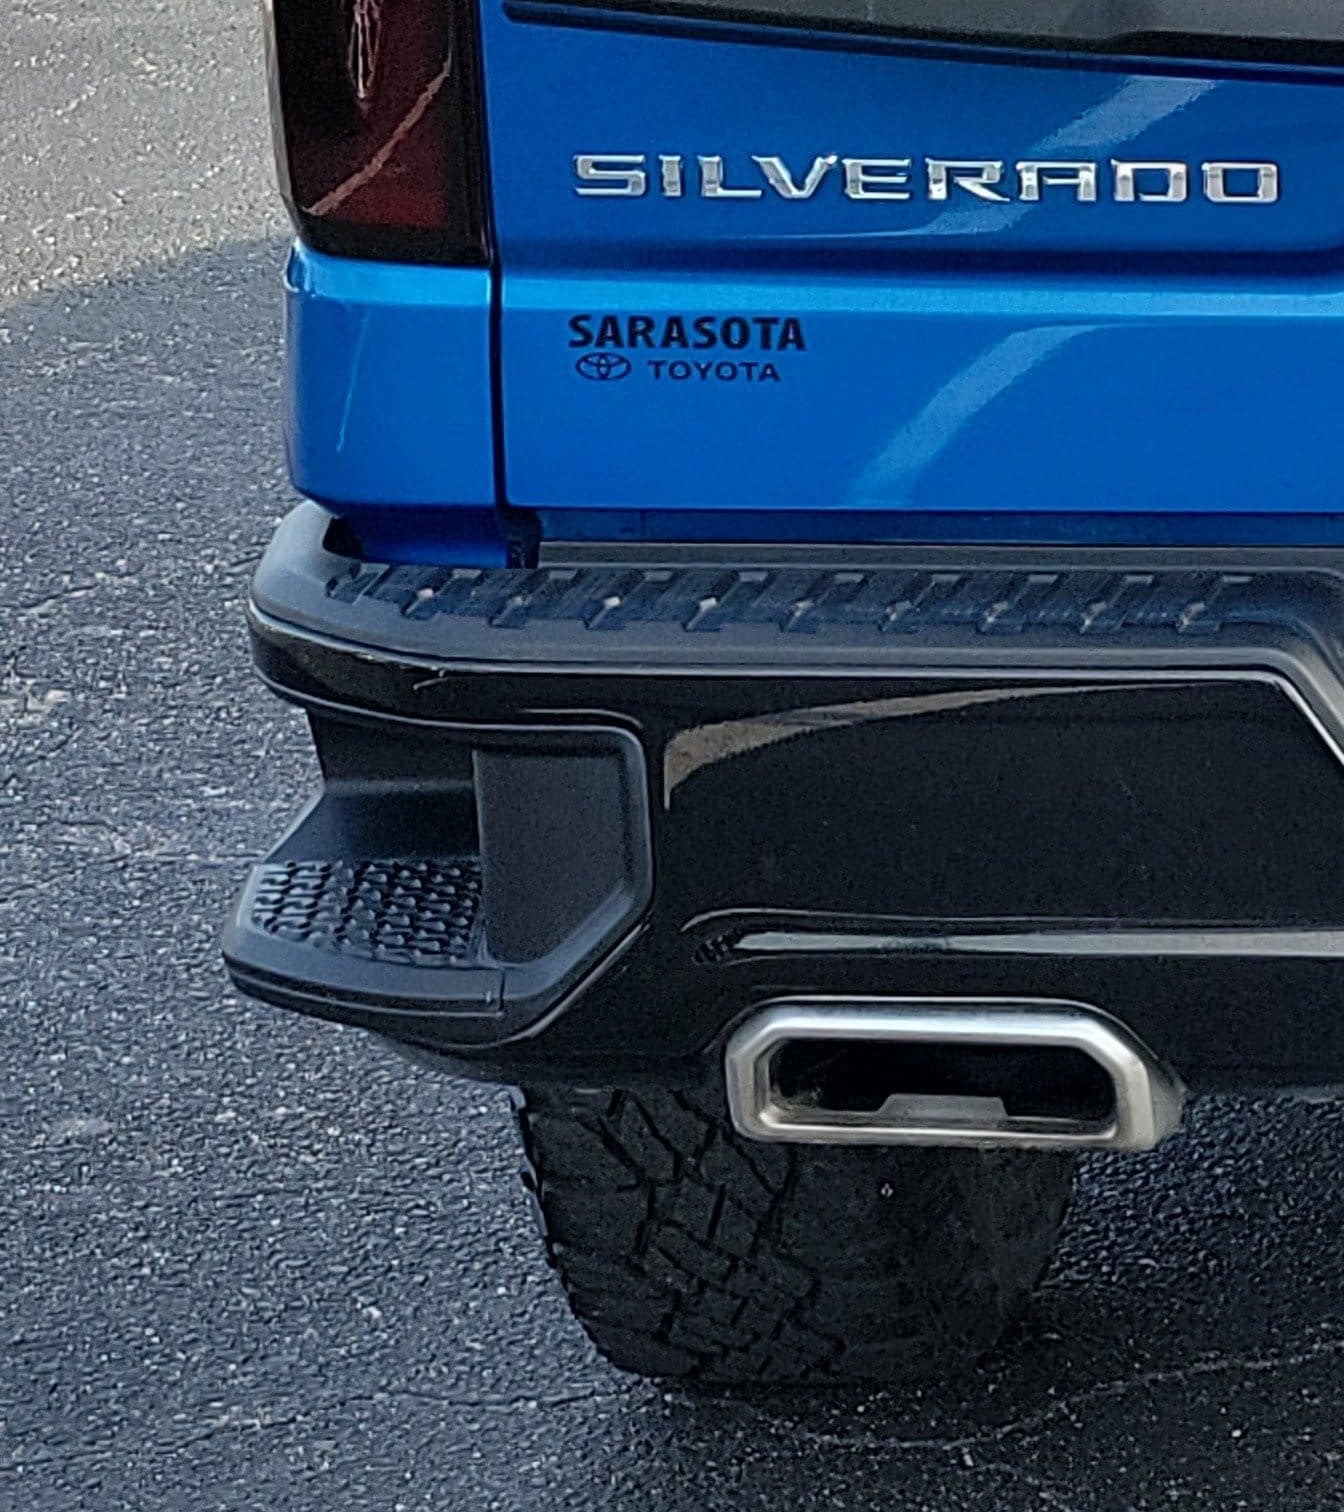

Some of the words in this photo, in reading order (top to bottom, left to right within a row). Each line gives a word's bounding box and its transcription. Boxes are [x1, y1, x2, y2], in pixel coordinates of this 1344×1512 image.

[573, 153, 1279, 204] SILVERADO
[568, 313, 808, 353] SARASOTA
[646, 358, 782, 383] TOYOTA
